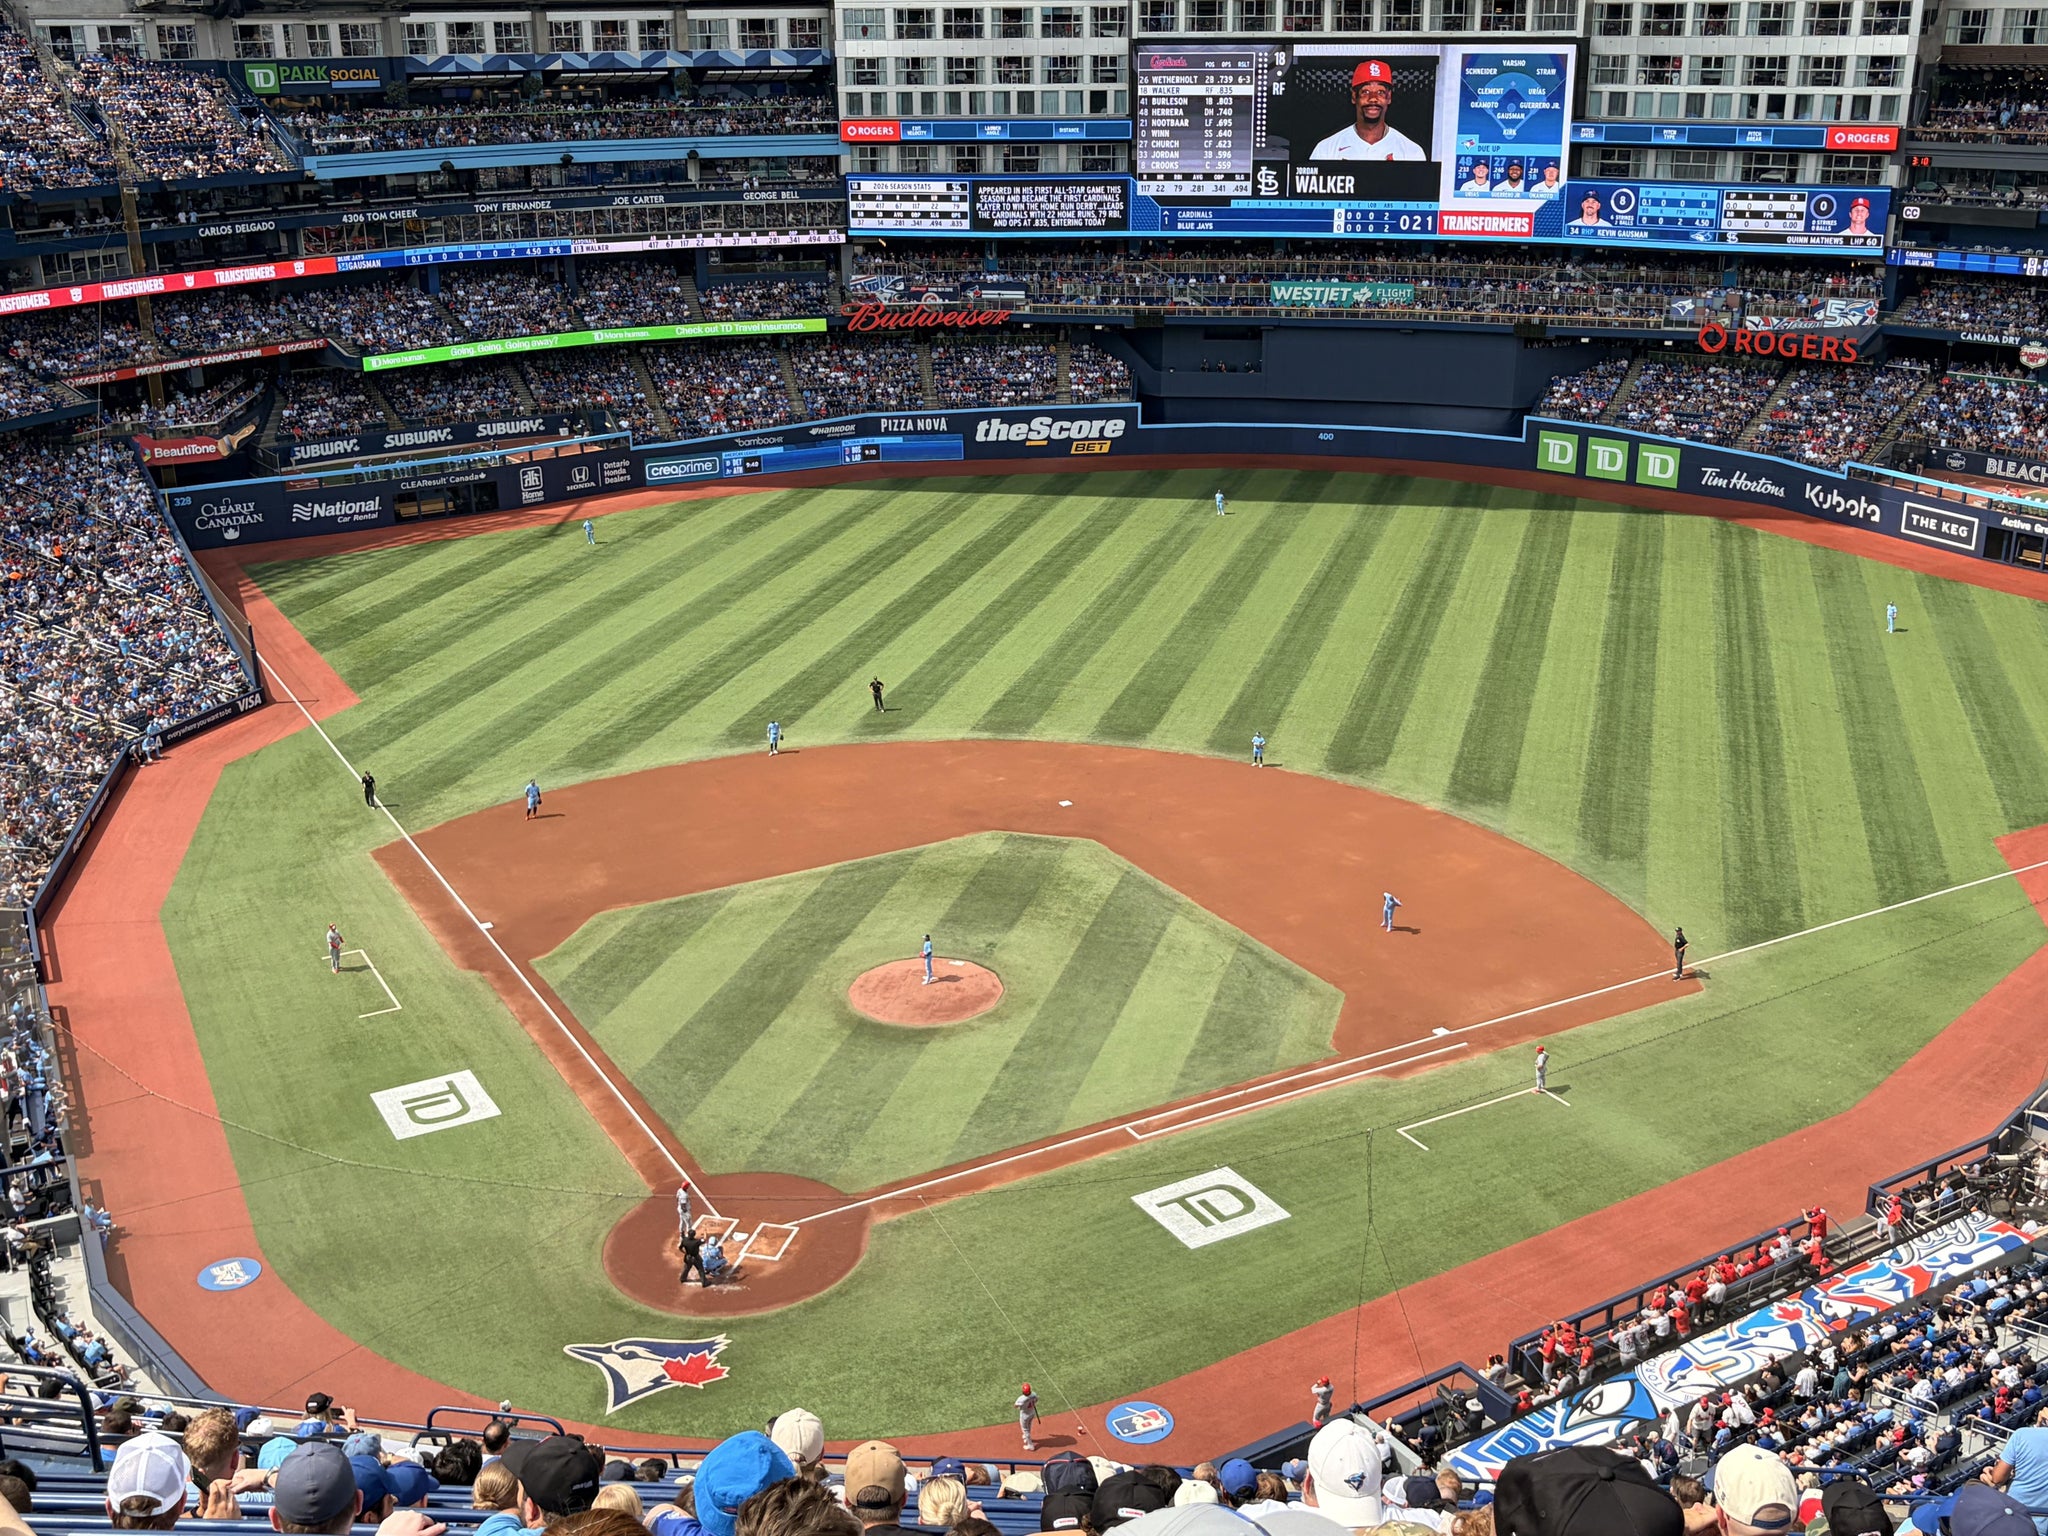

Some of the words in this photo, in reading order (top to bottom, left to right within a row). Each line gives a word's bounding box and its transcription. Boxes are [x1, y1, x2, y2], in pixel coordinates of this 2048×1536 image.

[1274, 52, 1286, 66] 18
[248, 69, 276, 88] TD
[280, 66, 330, 81] PARK
[330, 69, 380, 80] SOCIAL
[1152, 76, 1198, 84] WETHERHOLT
[1218, 76, 1233, 84] .739
[1272, 82, 1286, 95] RF
[858, 126, 894, 135] ROGERS
[1848, 133, 1890, 144] ROGERS
[1493, 157, 1506, 166] 27
[1295, 176, 1354, 194] WALKER
[612, 196, 631, 205] JOE
[632, 195, 665, 204] CARTER
[743, 192, 777, 200] GEORGE
[781, 191, 799, 199] BELL
[474, 203, 499, 213] TONY
[502, 201, 551, 211] FERNANDEZ
[342, 213, 365, 223] 4306
[366, 212, 388, 222] TOM
[389, 209, 418, 220] CHEEK
[992, 211, 1028, 219] CARDINALS
[199, 226, 233, 237] CARLOS
[235, 222, 275, 235] DELGADO
[1442, 216, 1529, 232] TRANSFORMERS
[1617, 230, 1648, 238] GAUSMAN
[1787, 236, 1808, 244] QUINN
[1810, 236, 1844, 245] MATHEWS
[348, 260, 381, 270] GAUSMAN
[214, 266, 276, 284] TRANSFORMERS
[102, 278, 164, 298] TRANSFORMERS
[1273, 286, 1352, 304] WESTJET
[1376, 289, 1412, 298] FLIGHT
[840, 302, 1013, 331] Budweiser
[676, 325, 702, 336] Check
[704, 325, 719, 334] out
[735, 323, 760, 332] Travel
[505, 341, 530, 352] Going
[531, 336, 558, 348] away?
[1735, 329, 1859, 363] ROGERS
[1960, 332, 2000, 343] CANADA
[2002, 336, 2020, 345] DRY
[286, 342, 313, 353] ROGERS
[136, 365, 161, 376] PROUD
[162, 361, 190, 371] OWNER
[191, 358, 200, 367] OF
[202, 353, 240, 366] CANADA'S
[242, 349, 262, 359] TEAM
[476, 418, 545, 438] SUBWAY
[881, 418, 913, 432] PIZZA
[917, 417, 948, 431] NOVA
[975, 416, 1125, 442] theScore
[384, 428, 453, 448] SUBWAY
[154, 444, 216, 458] BeautiTone
[292, 438, 360, 460] SUBWAY
[1074, 442, 1107, 453] BET
[1543, 438, 1574, 464] TD
[603, 459, 630, 469] Ontario
[1592, 445, 1623, 471] TD
[1642, 451, 1675, 479] TD
[604, 468, 627, 476] Honda
[605, 474, 631, 484] Dealers
[400, 477, 447, 490] CLEAResult
[449, 473, 479, 483] Canada
[566, 481, 596, 491] HONDA
[1701, 467, 1726, 488] Tim
[1729, 470, 1784, 498] Hortons
[173, 496, 192, 506] 328
[522, 490, 544, 500] Home
[1805, 482, 1880, 523] Kubota
[201, 502, 255, 517] CLEARLY
[313, 496, 382, 518] National
[195, 513, 264, 530] CANADIAN
[337, 515, 352, 523] Car
[353, 512, 378, 521] Rental
[2001, 517, 2031, 531] Active
[1911, 514, 1937, 530] THE
[1942, 522, 1969, 537] KEG
[237, 693, 262, 713] VISA
[167, 720, 197, 740] everywhere
[196, 718, 206, 730] you
[206, 713, 219, 724] want
[1155, 1184, 1256, 1228] TD
